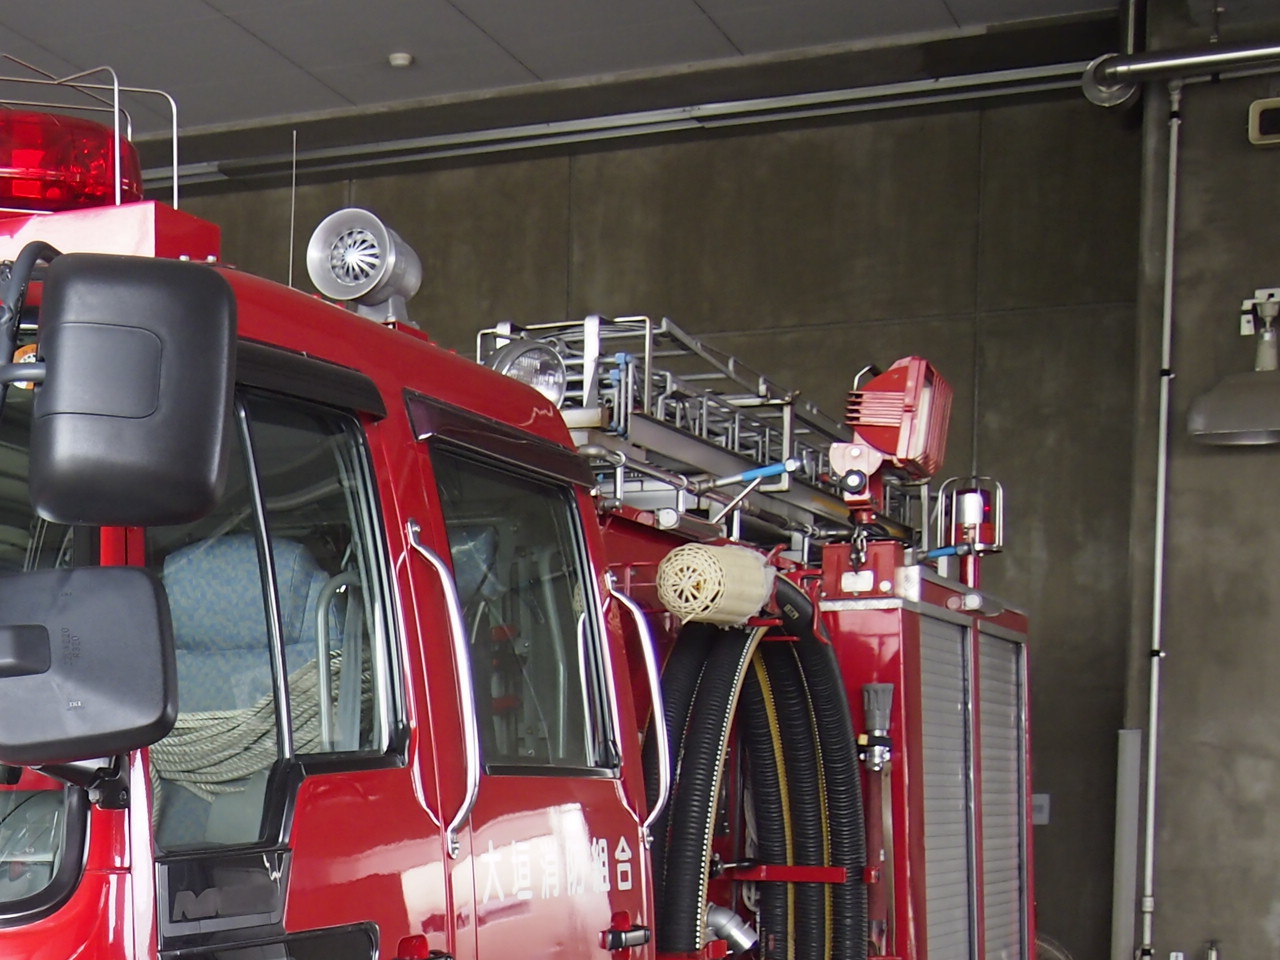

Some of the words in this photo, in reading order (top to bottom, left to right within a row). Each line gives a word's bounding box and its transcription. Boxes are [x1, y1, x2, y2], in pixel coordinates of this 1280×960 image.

[481, 835, 633, 905] 大垣消防組合
